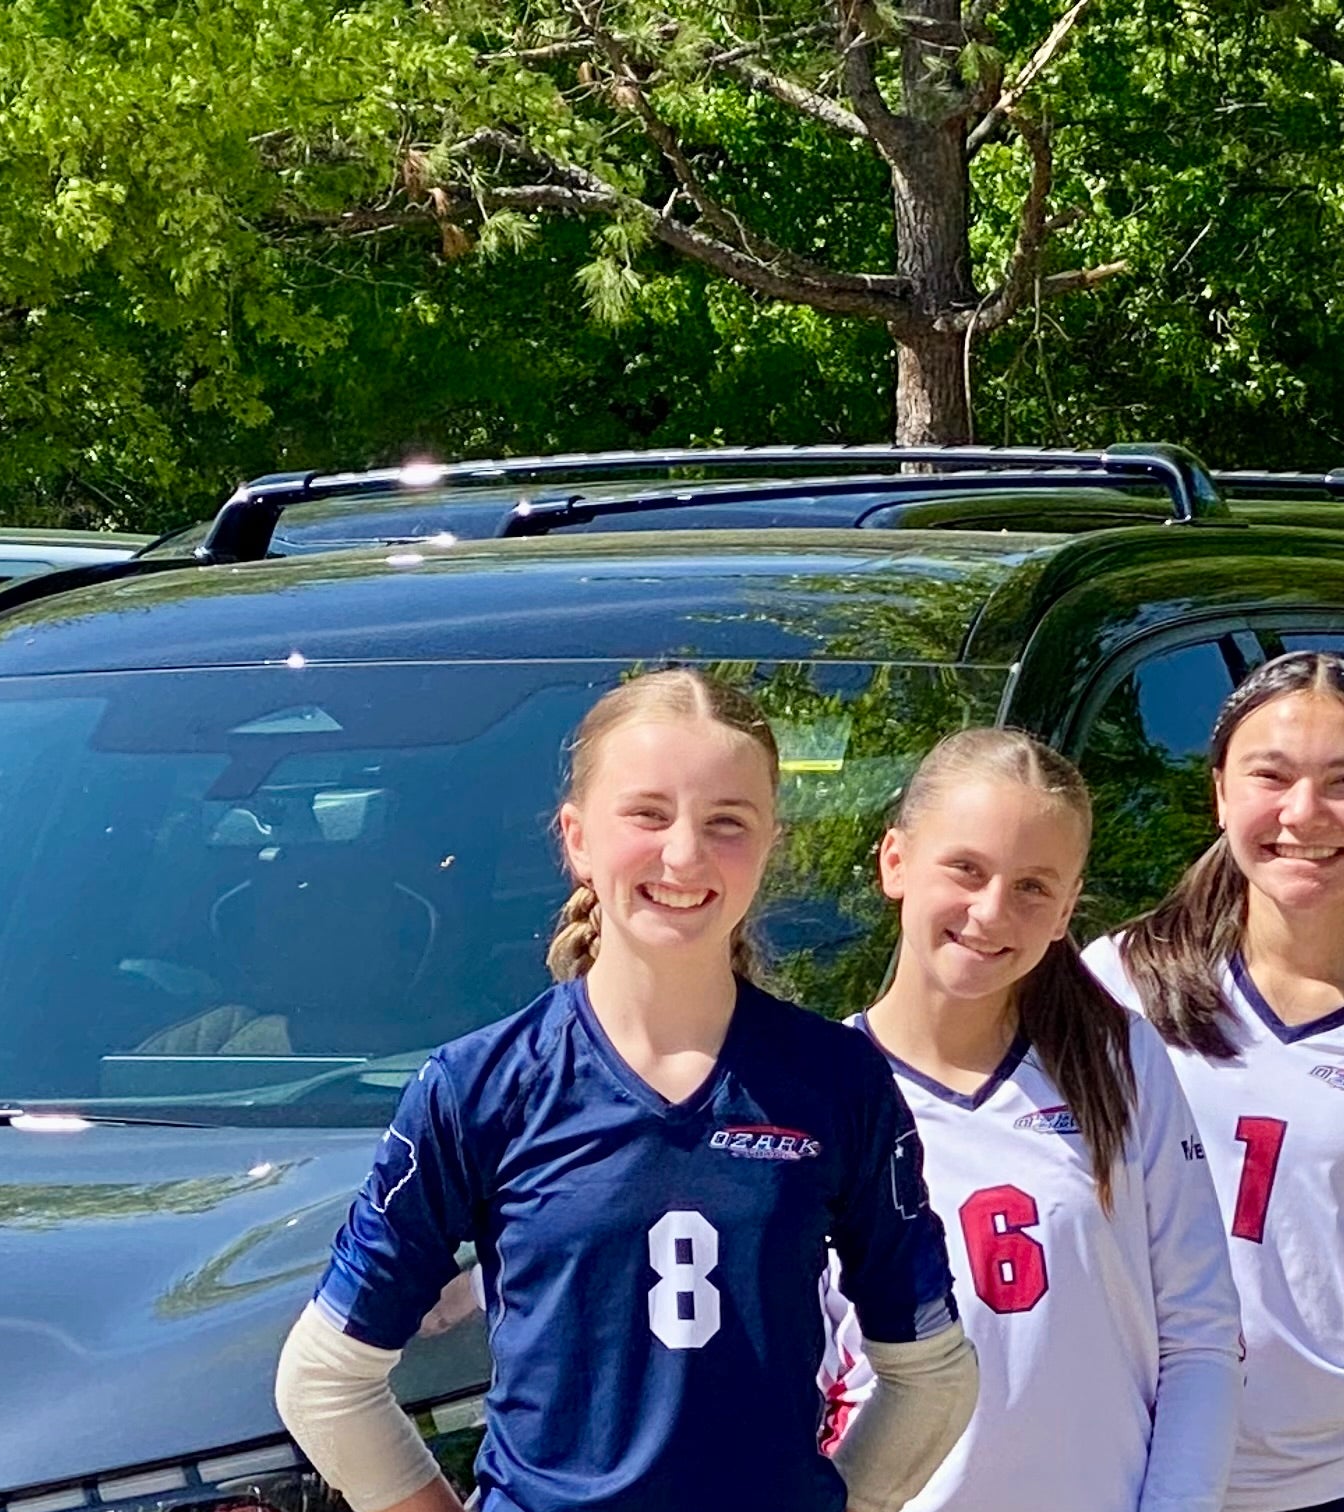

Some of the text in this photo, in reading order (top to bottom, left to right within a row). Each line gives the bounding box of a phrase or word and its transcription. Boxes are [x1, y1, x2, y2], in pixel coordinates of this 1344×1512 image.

[709, 1131, 820, 1156] OZARK
[1231, 1115, 1288, 1244] 1
[648, 1210, 721, 1350] 8
[959, 1184, 1049, 1315] 6
